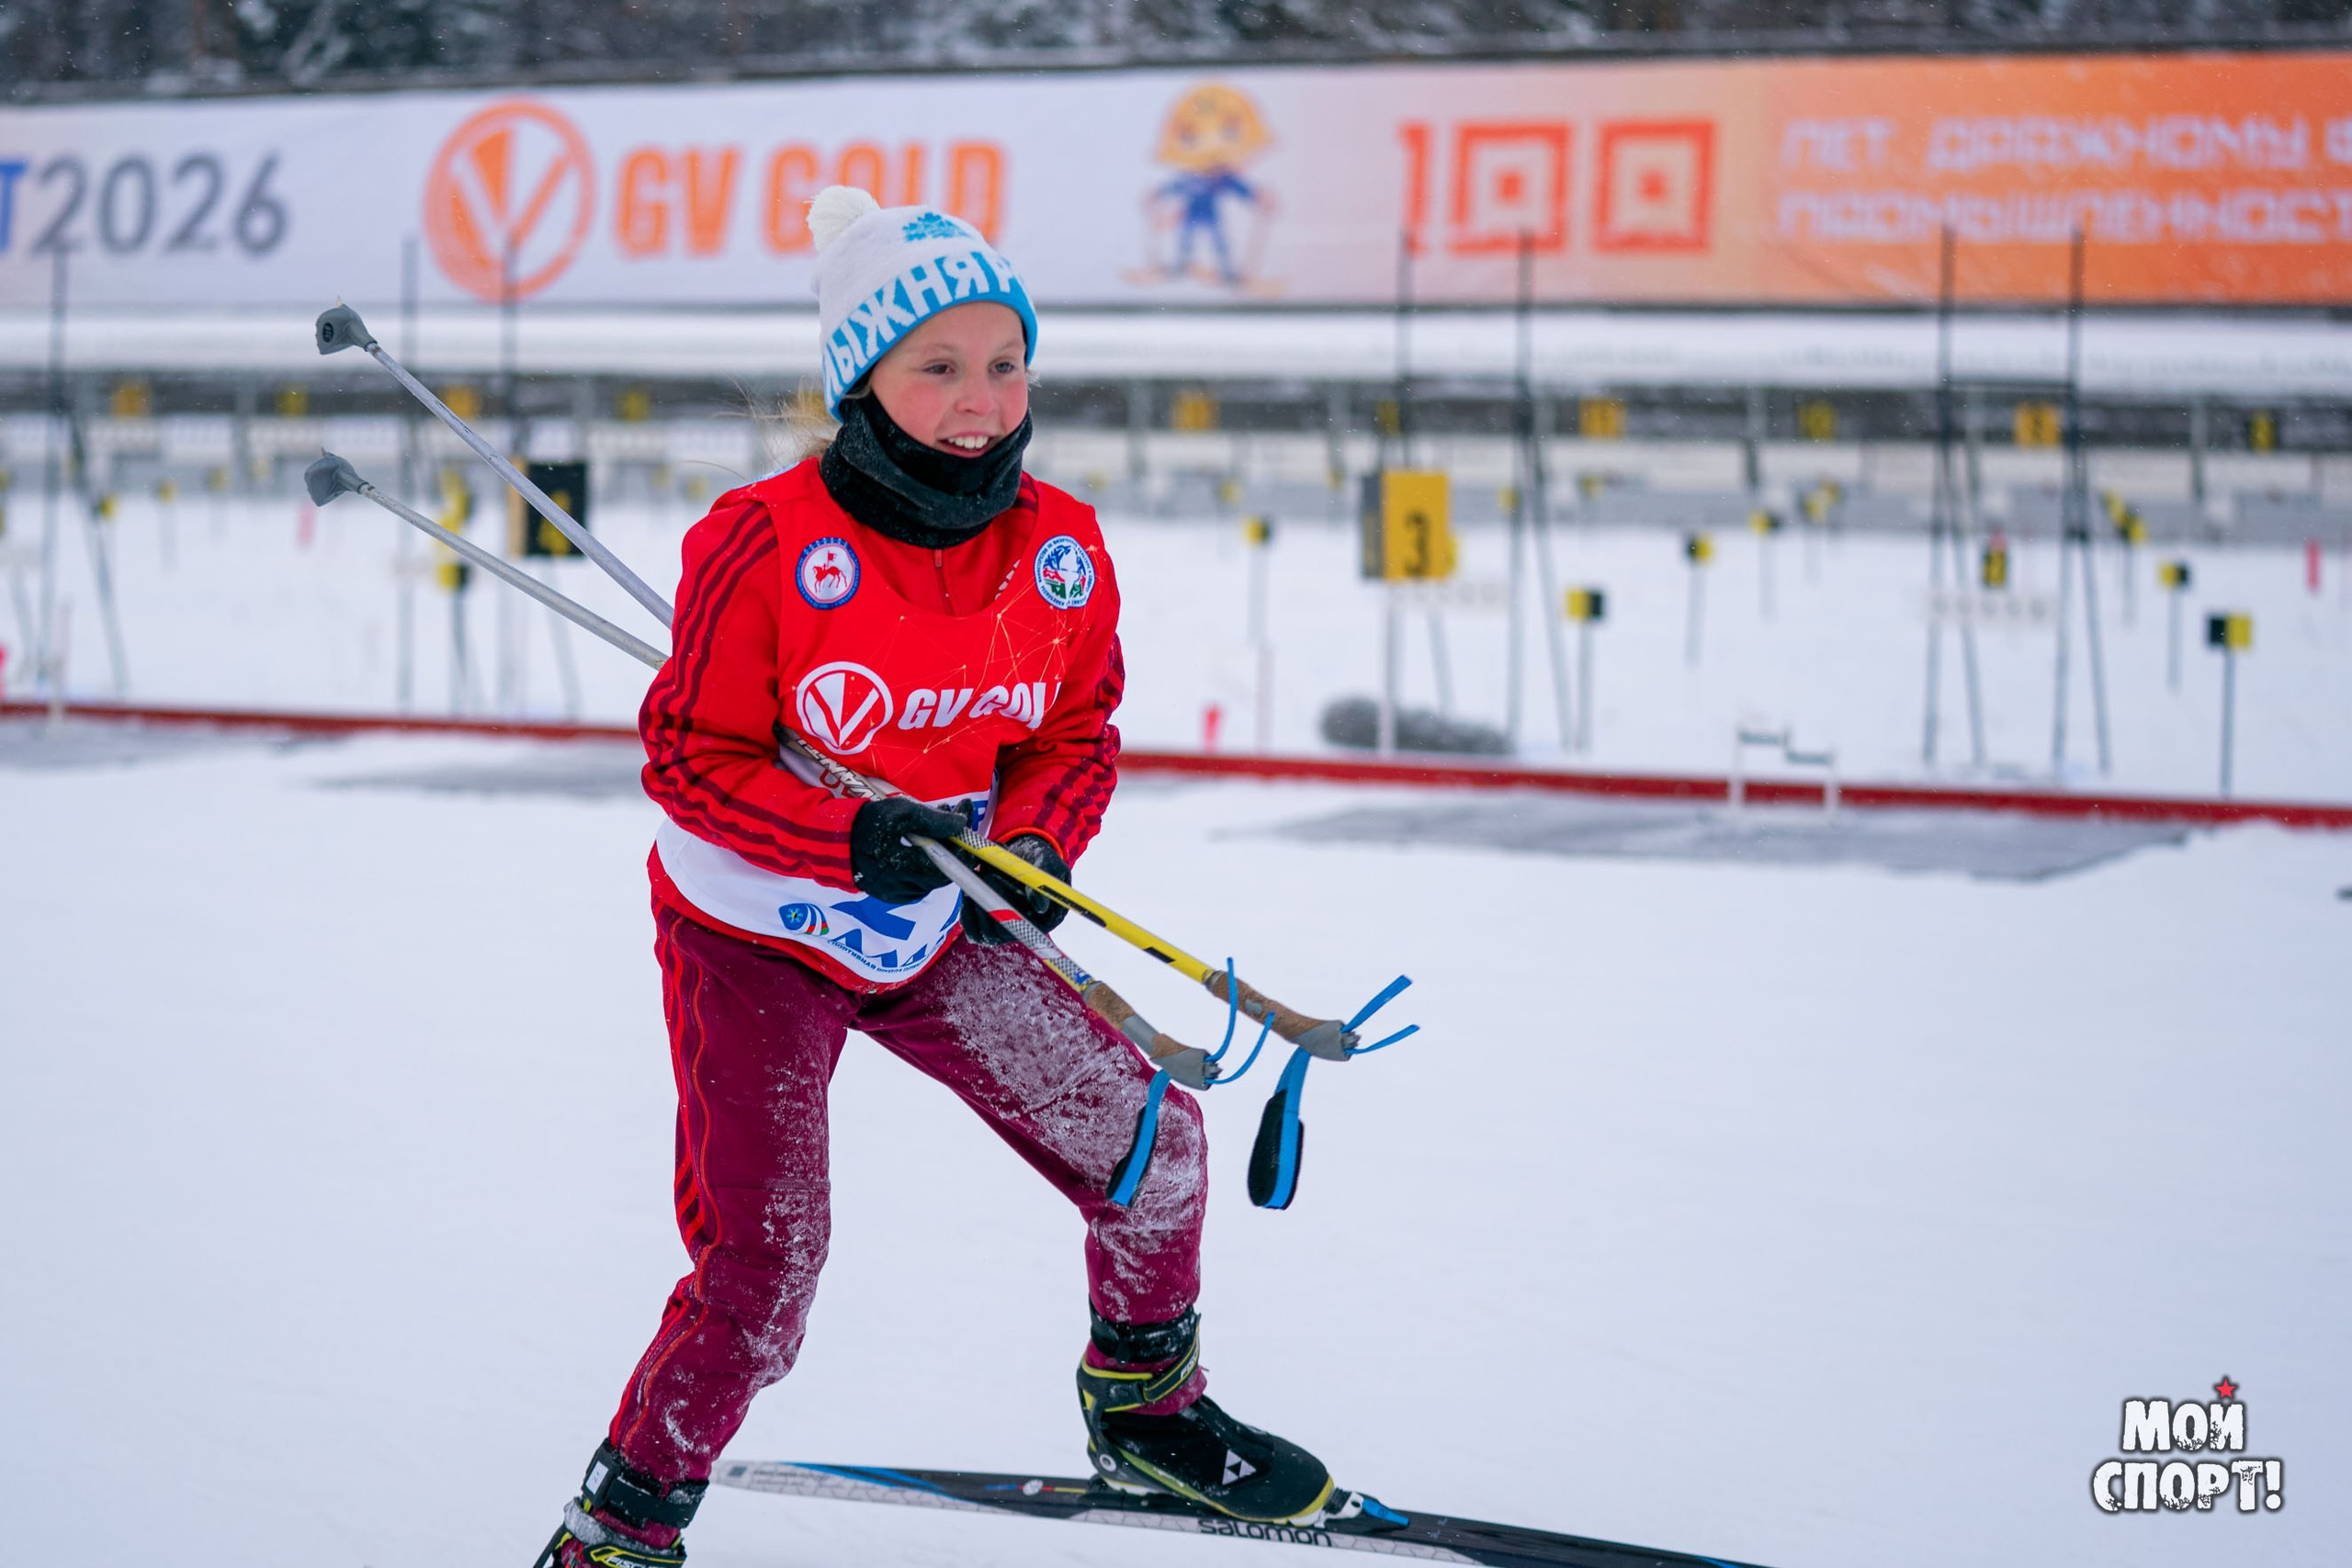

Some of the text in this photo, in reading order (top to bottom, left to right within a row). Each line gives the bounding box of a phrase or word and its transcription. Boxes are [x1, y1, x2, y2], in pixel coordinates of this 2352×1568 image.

[614, 145, 741, 258] GV
[1403, 510, 1430, 580] 3
[898, 688, 975, 731] GV
[1197, 1517, 1332, 1548] salomon
